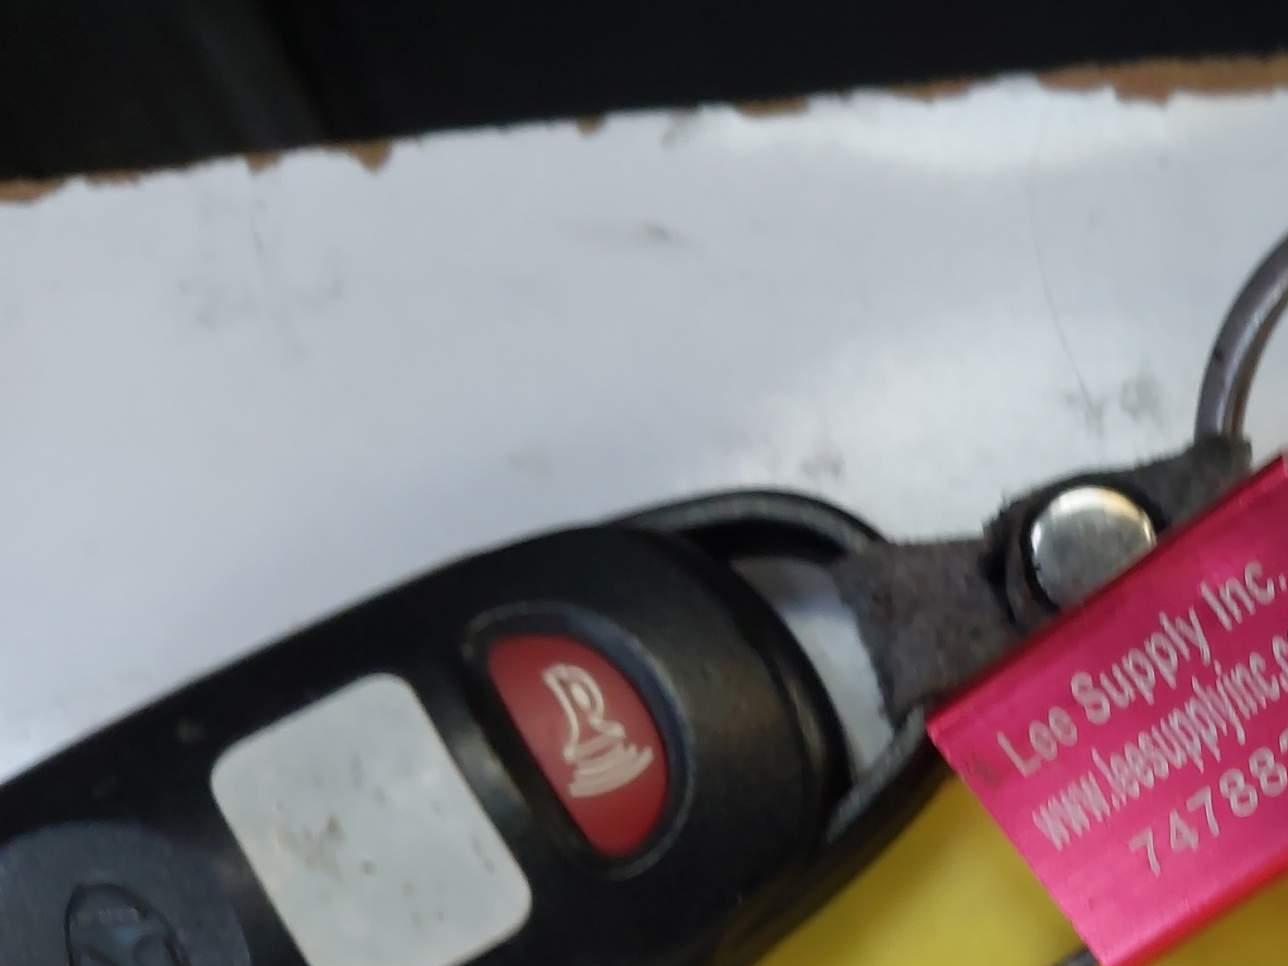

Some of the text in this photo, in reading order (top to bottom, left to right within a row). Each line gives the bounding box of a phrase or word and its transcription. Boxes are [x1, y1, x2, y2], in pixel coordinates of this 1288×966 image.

[997, 561, 1288, 777] Lee Supply Inc.
